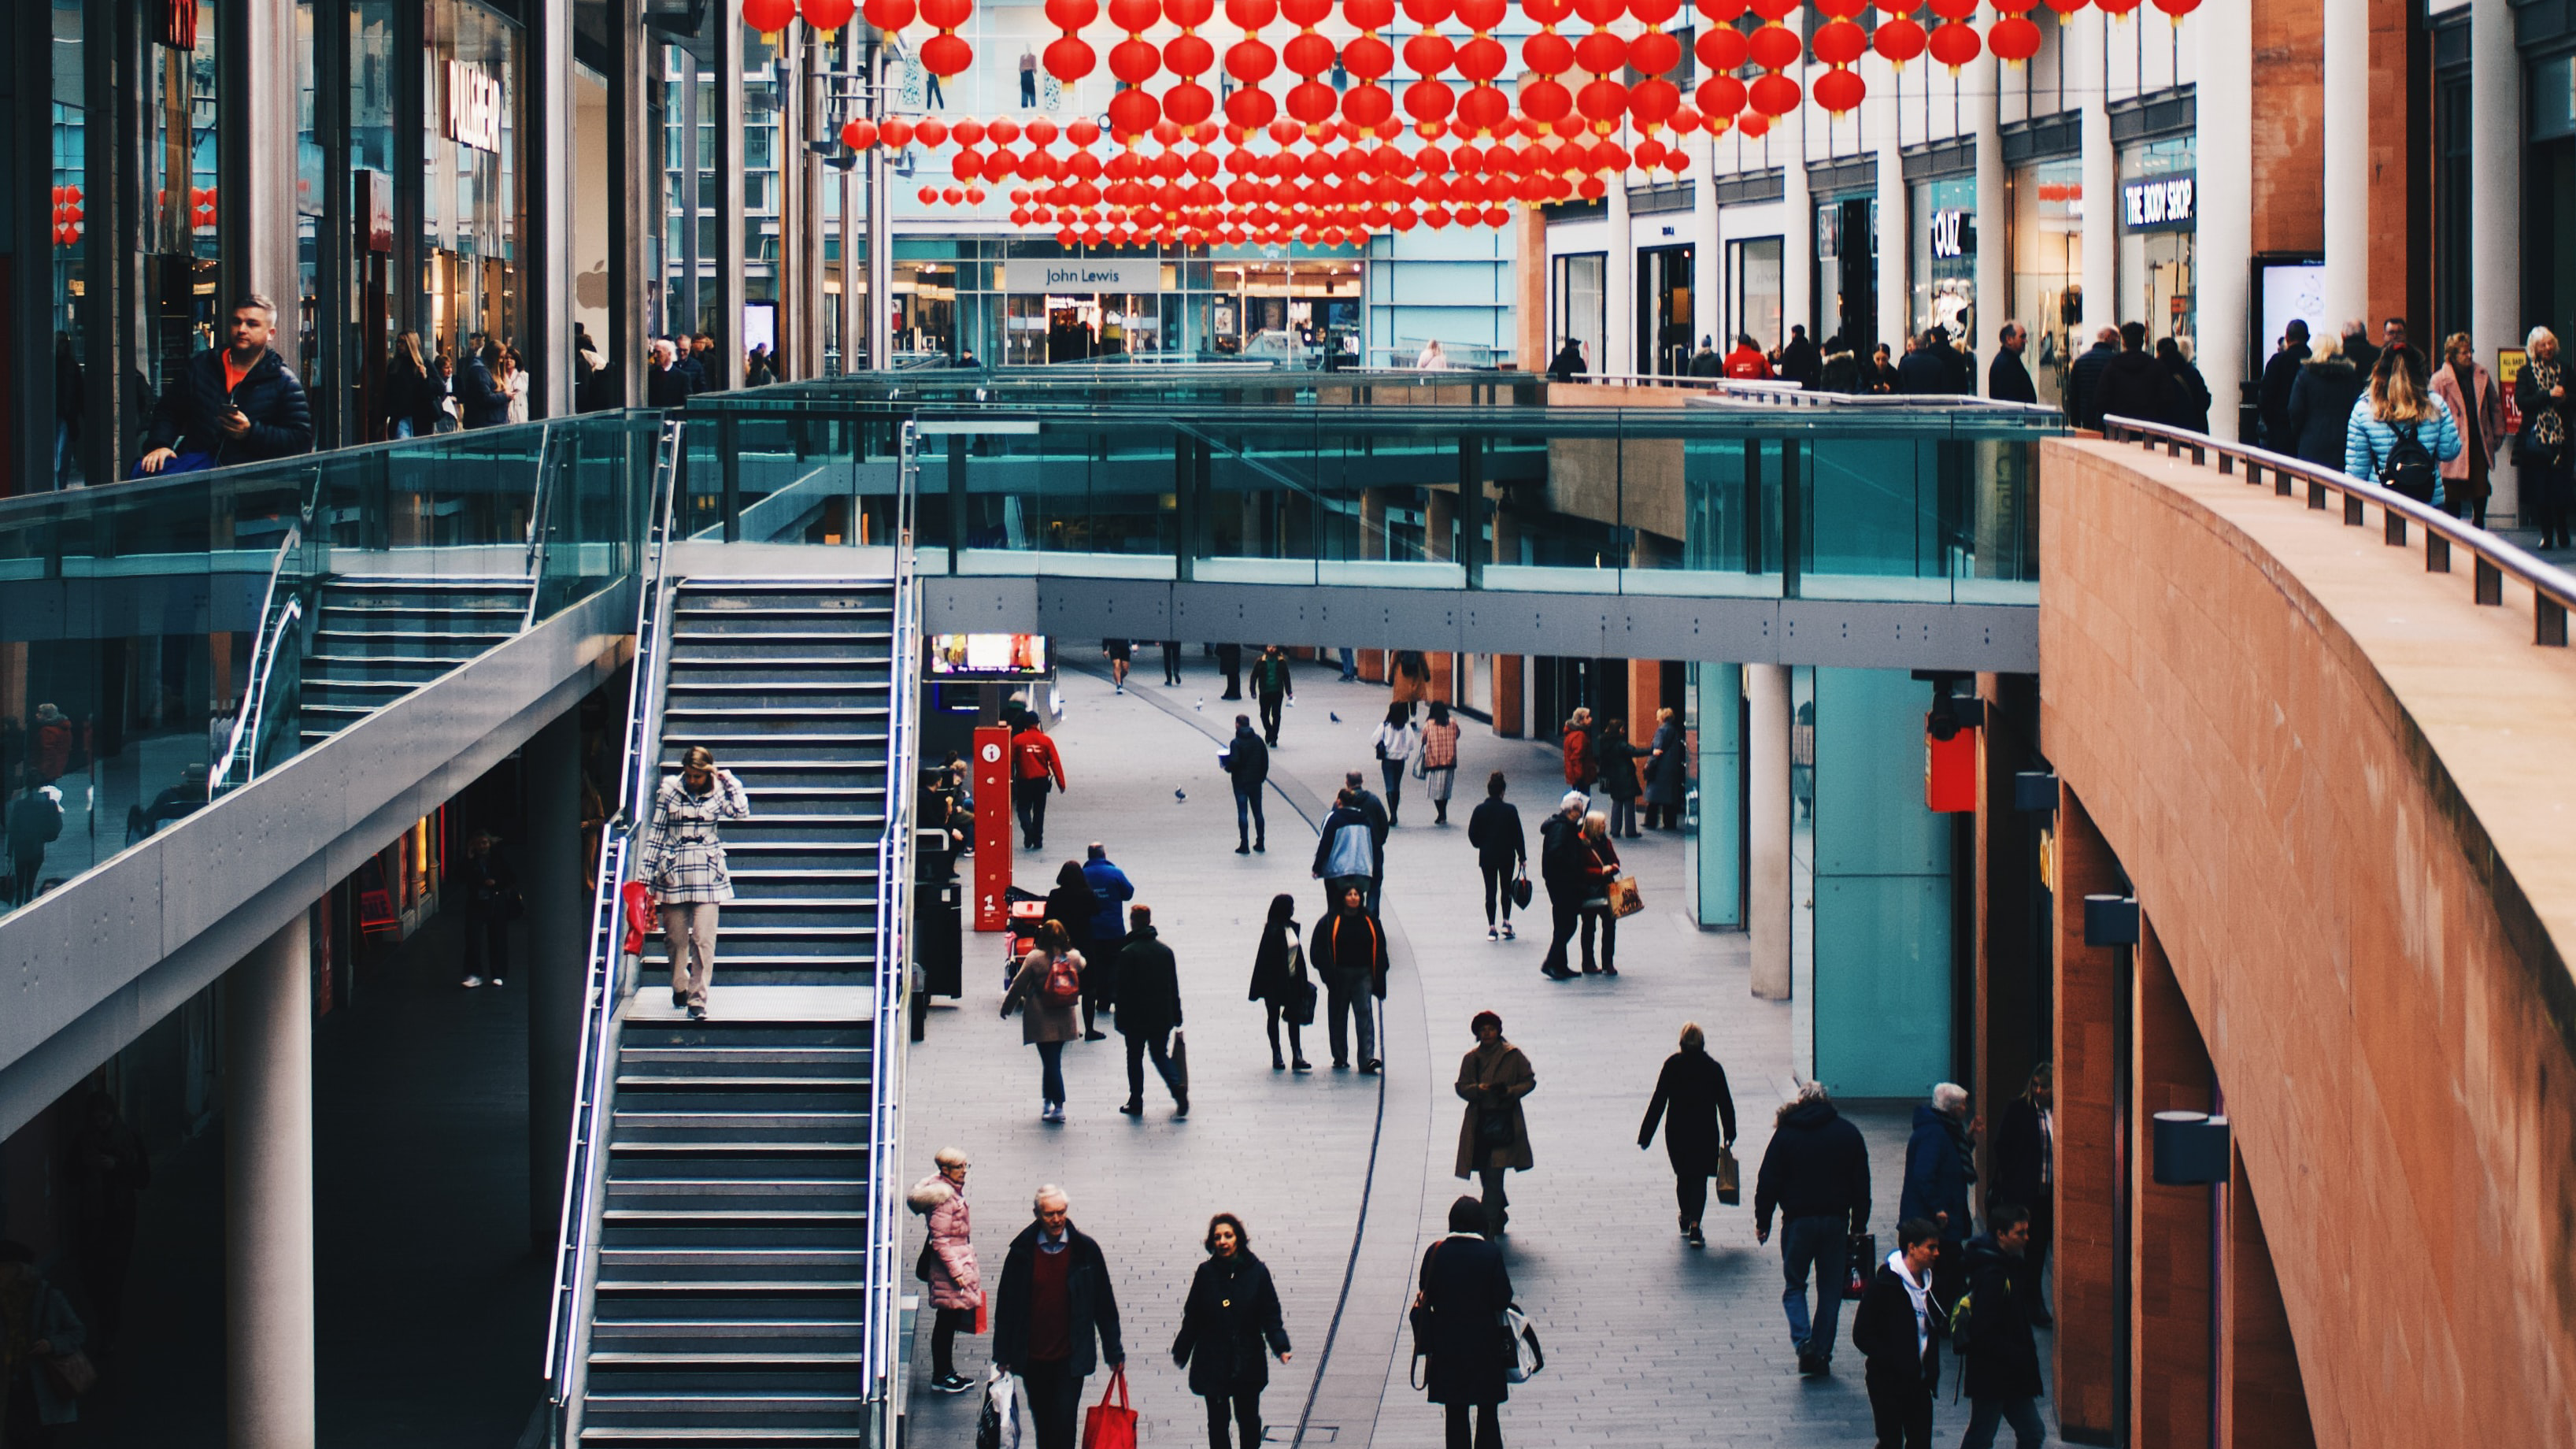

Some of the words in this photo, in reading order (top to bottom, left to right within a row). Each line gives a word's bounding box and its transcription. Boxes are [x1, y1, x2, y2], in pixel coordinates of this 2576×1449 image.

[2126, 185, 2144, 225] THE
[2144, 181, 2167, 224] BODY
[1935, 211, 1961, 258] QUIZ
[1046, 269, 1078, 286] John
[1082, 269, 1120, 282] Lewis
[983, 895, 996, 910] 1
